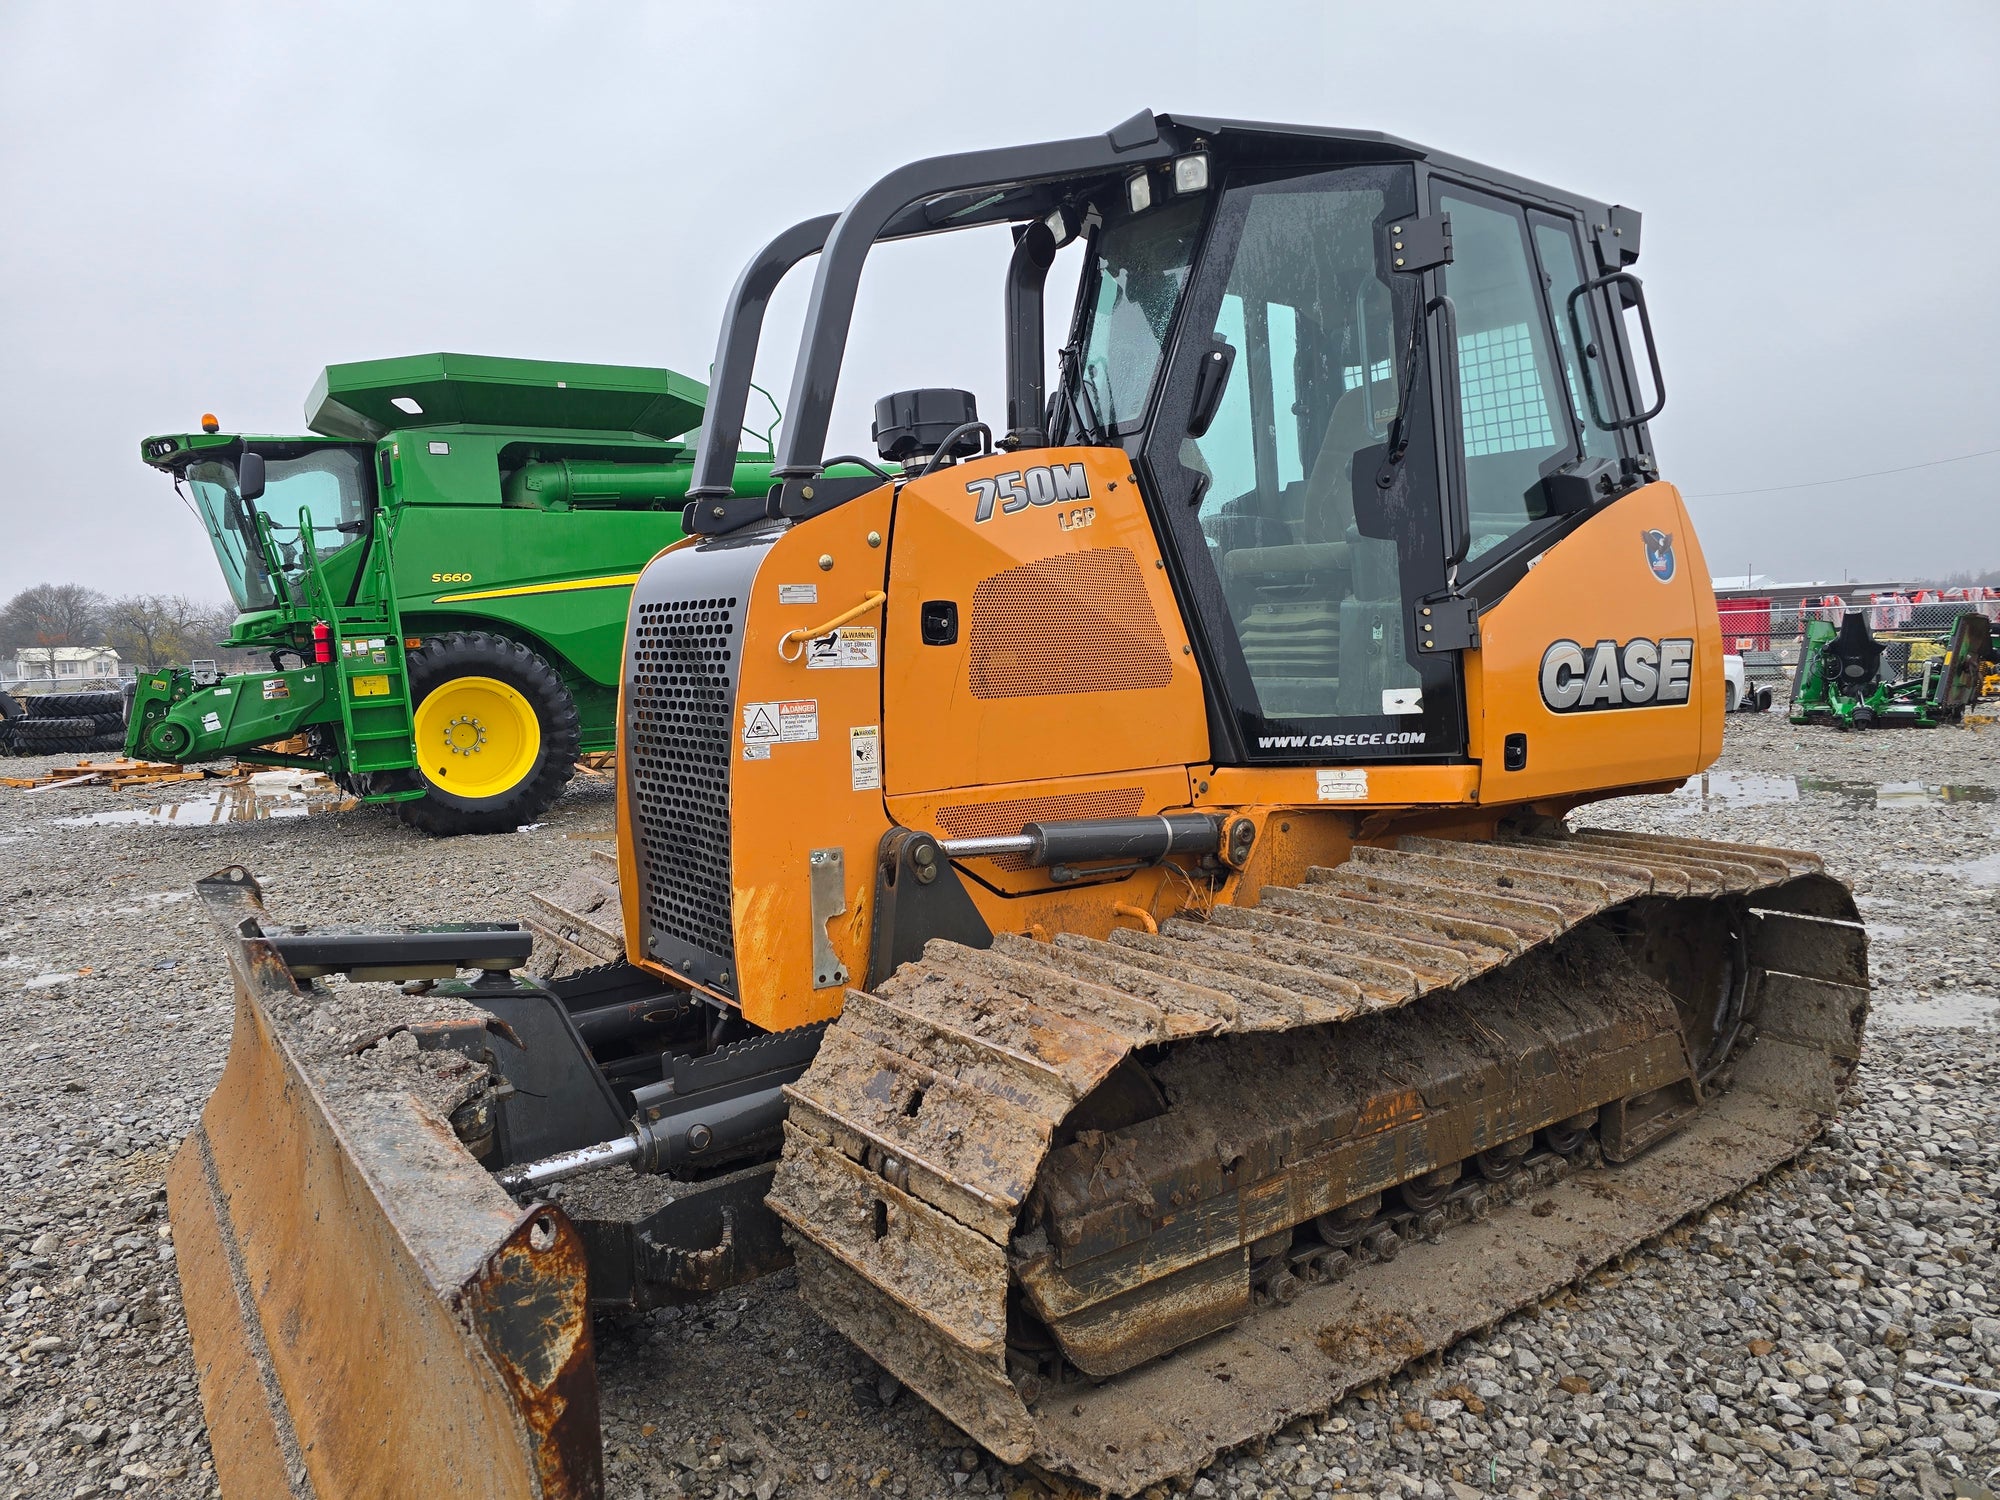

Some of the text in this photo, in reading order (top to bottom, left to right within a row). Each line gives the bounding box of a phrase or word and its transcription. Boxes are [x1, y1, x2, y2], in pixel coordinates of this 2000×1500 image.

[1375, 407, 1397, 419] ASE
[966, 462, 1091, 525] 750M
[1058, 507, 1096, 532] LGP
[431, 573, 472, 583] S660
[1540, 638, 1695, 710] CASE
[789, 705, 815, 713] DANGER
[1258, 731, 1427, 749] WWW.CASECE.COM
